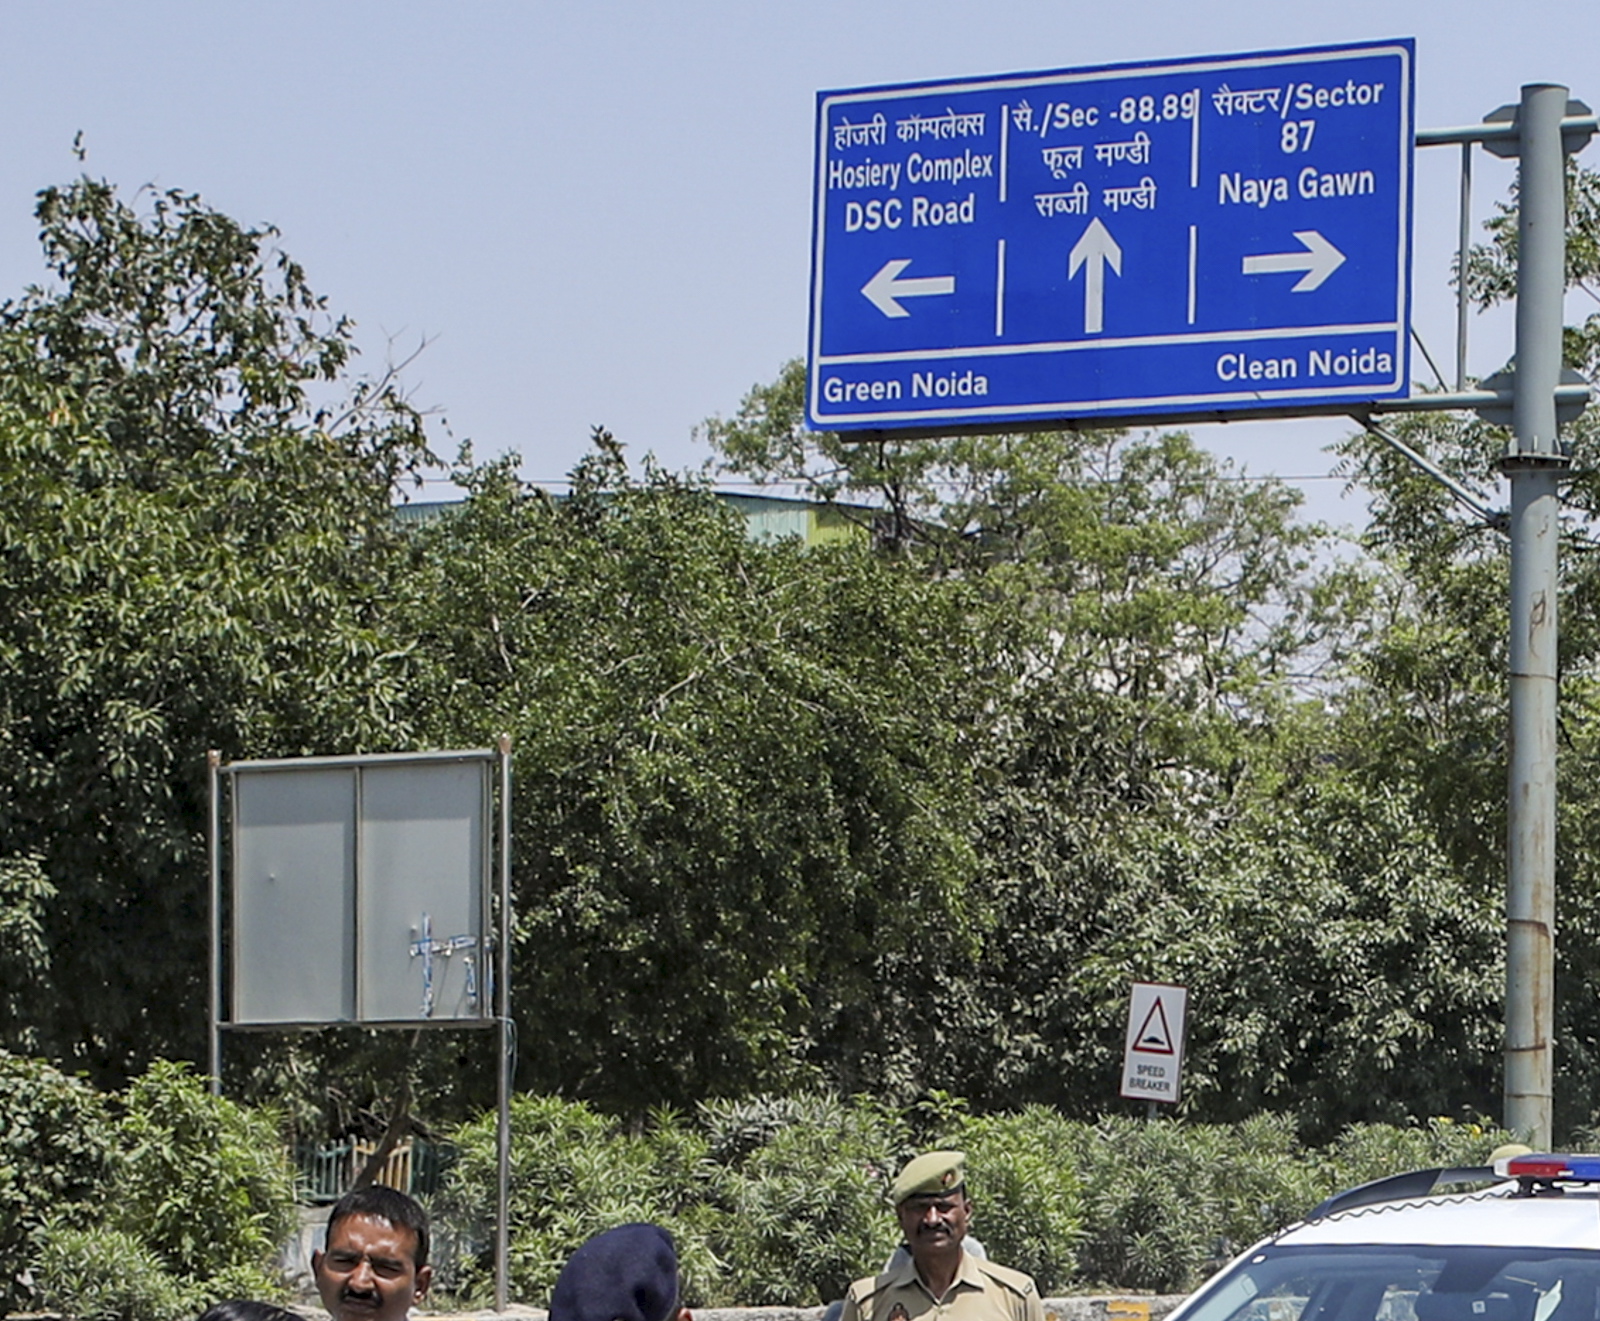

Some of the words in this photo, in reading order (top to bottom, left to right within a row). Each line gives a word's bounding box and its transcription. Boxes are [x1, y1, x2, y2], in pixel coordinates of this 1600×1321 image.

[834, 112, 887, 151] होजरी
[896, 106, 986, 143] कॉम्पलेक्स
[1281, 119, 1316, 154] 87
[828, 157, 901, 191] Hosiery
[907, 149, 993, 186] Complex
[1042, 145, 1084, 180] फूल
[1094, 130, 1151, 167] मण्डी
[1034, 181, 1090, 217] सब्जी
[1103, 176, 1158, 213] मण्डी
[1219, 172, 1289, 208] Naya
[1299, 166, 1375, 199] Gawn
[845, 198, 903, 232] DSC
[912, 193, 975, 227] Road
[1215, 352, 1297, 382] Clean
[1308, 348, 1393, 377] Noida
[823, 378, 901, 404] Green
[911, 371, 989, 398] Noida
[1129, 1077, 1171, 1093] BREAKER
[1137, 1064, 1166, 1078] SPEED
